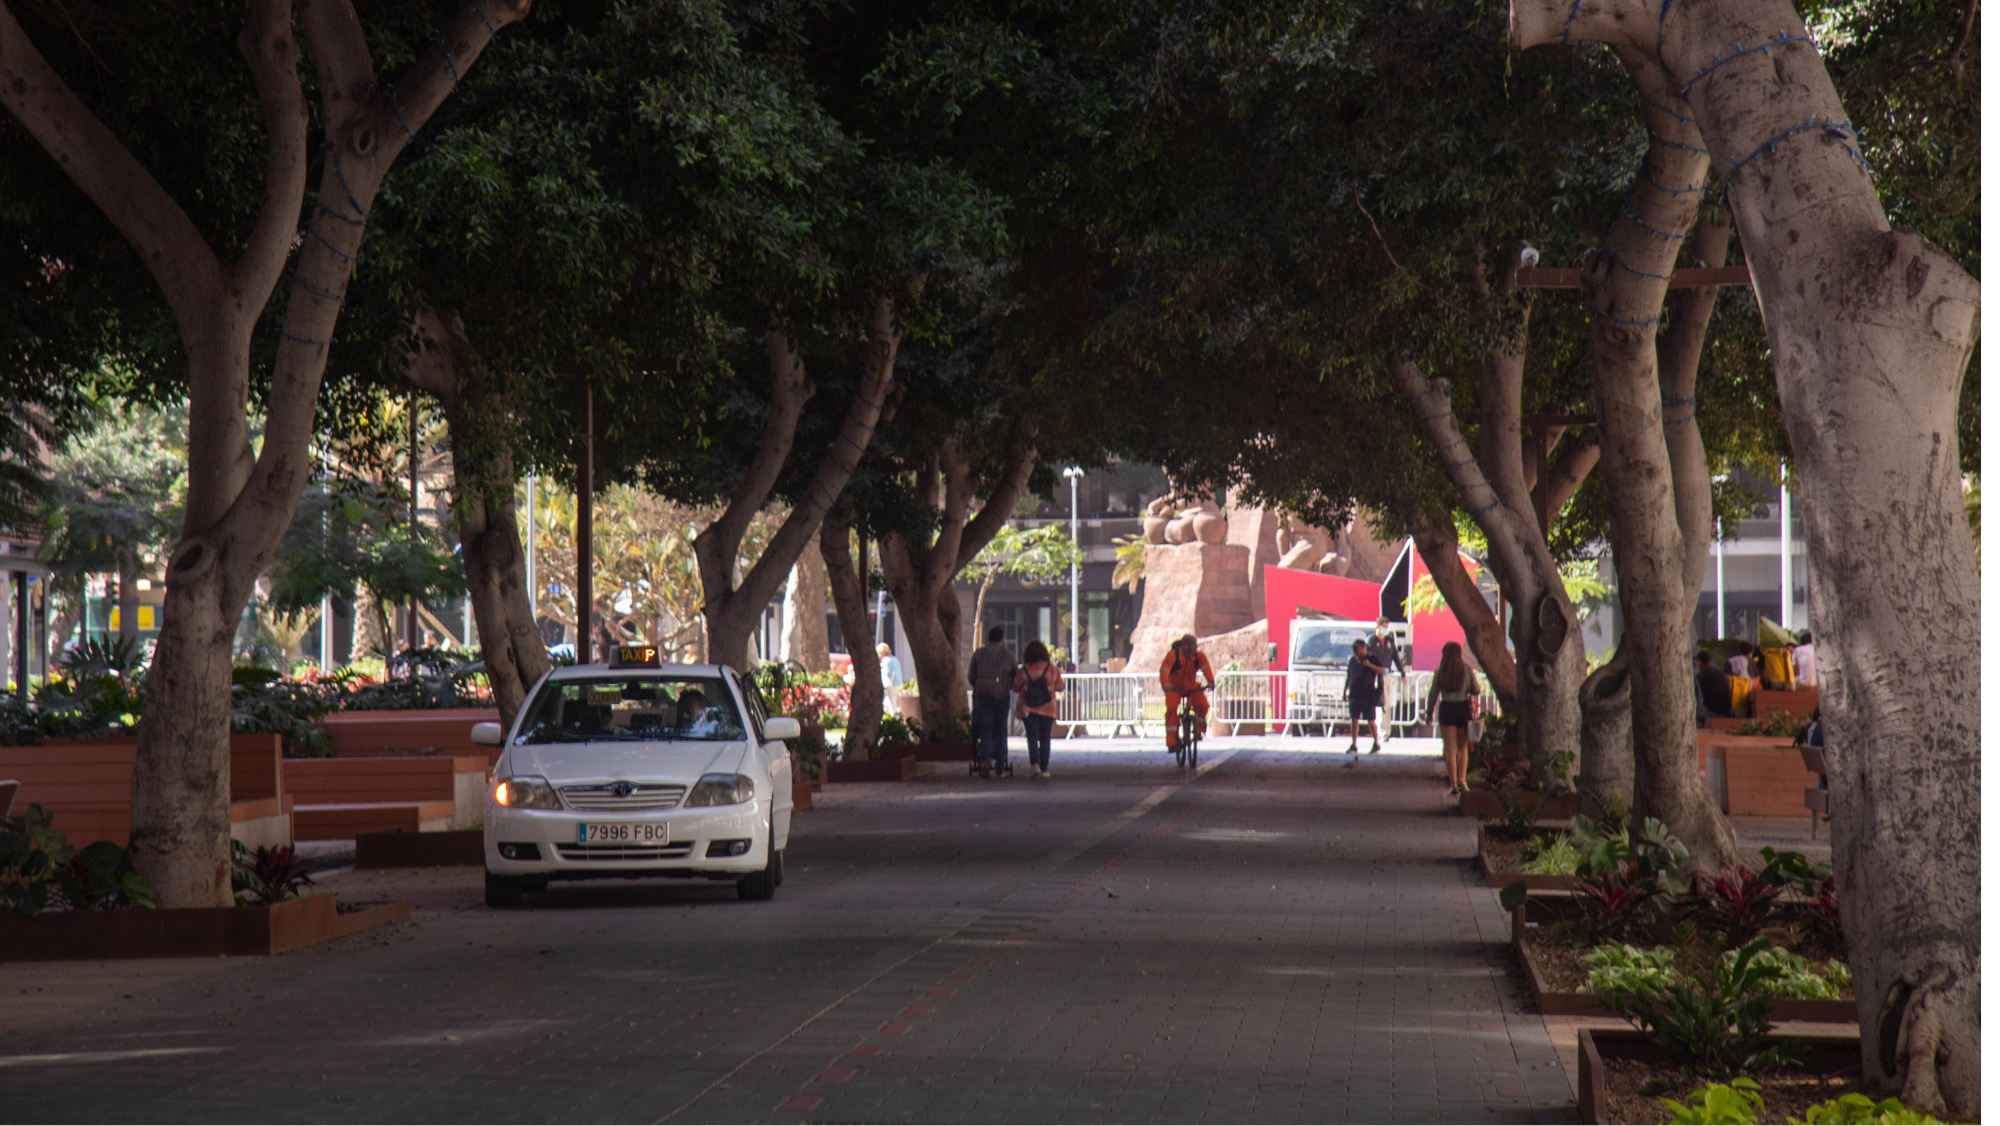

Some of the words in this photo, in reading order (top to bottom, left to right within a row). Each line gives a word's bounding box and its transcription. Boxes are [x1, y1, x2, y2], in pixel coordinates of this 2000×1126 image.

[620, 648, 645, 661] TAXI
[645, 648, 656, 662] P
[590, 825, 628, 840] 7996
[634, 825, 664, 840] FBC
